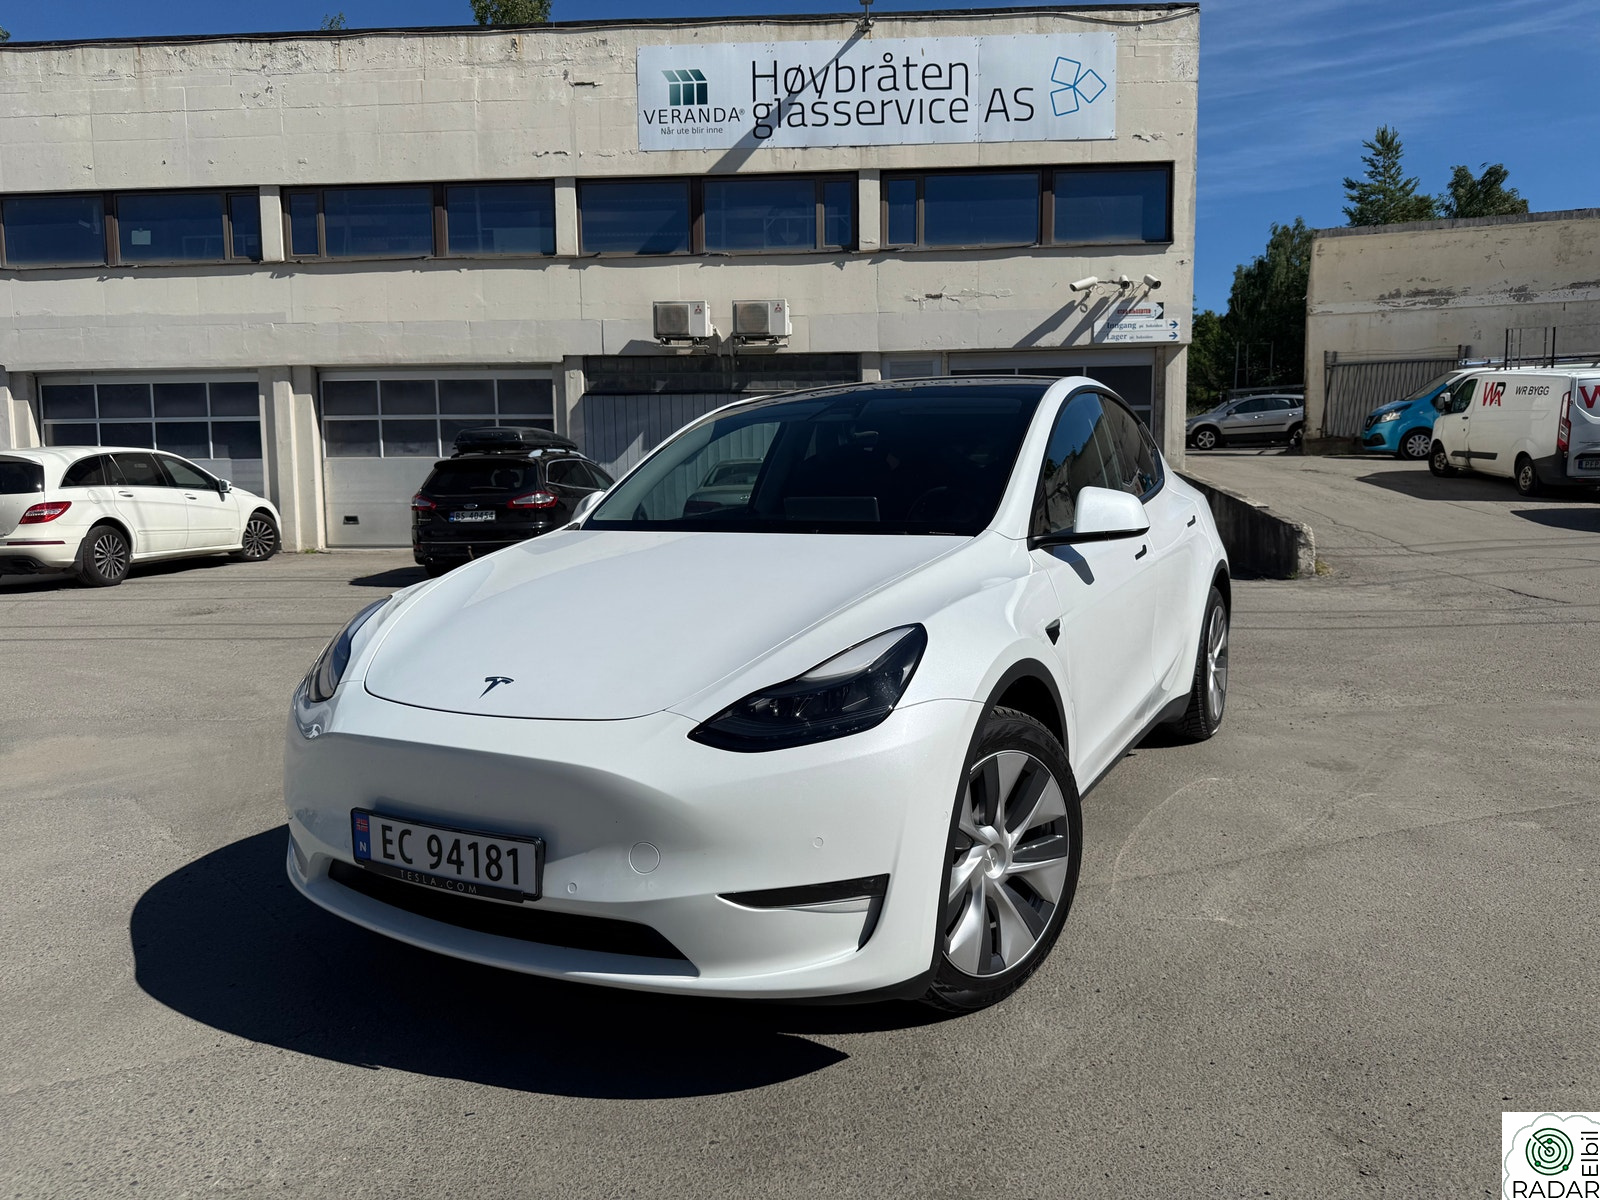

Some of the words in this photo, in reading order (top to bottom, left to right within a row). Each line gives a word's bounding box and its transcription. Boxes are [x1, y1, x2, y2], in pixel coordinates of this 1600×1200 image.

[751, 52, 969, 101] Høvbråten
[752, 95, 969, 139] glasservice
[984, 87, 1035, 123] AS
[660, 126, 675, 135] Når
[677, 127, 690, 135] ute
[691, 126, 705, 134] blir
[706, 126, 724, 134] inne
[1106, 322, 1137, 330] Inngang
[1106, 333, 1127, 341] Lager
[1515, 385, 1528, 396] WR
[1528, 385, 1550, 396] BYGG
[359, 841, 367, 853] N
[381, 824, 413, 865] EC
[427, 833, 519, 885] 94181
[399, 869, 478, 895] TESLA.COM
